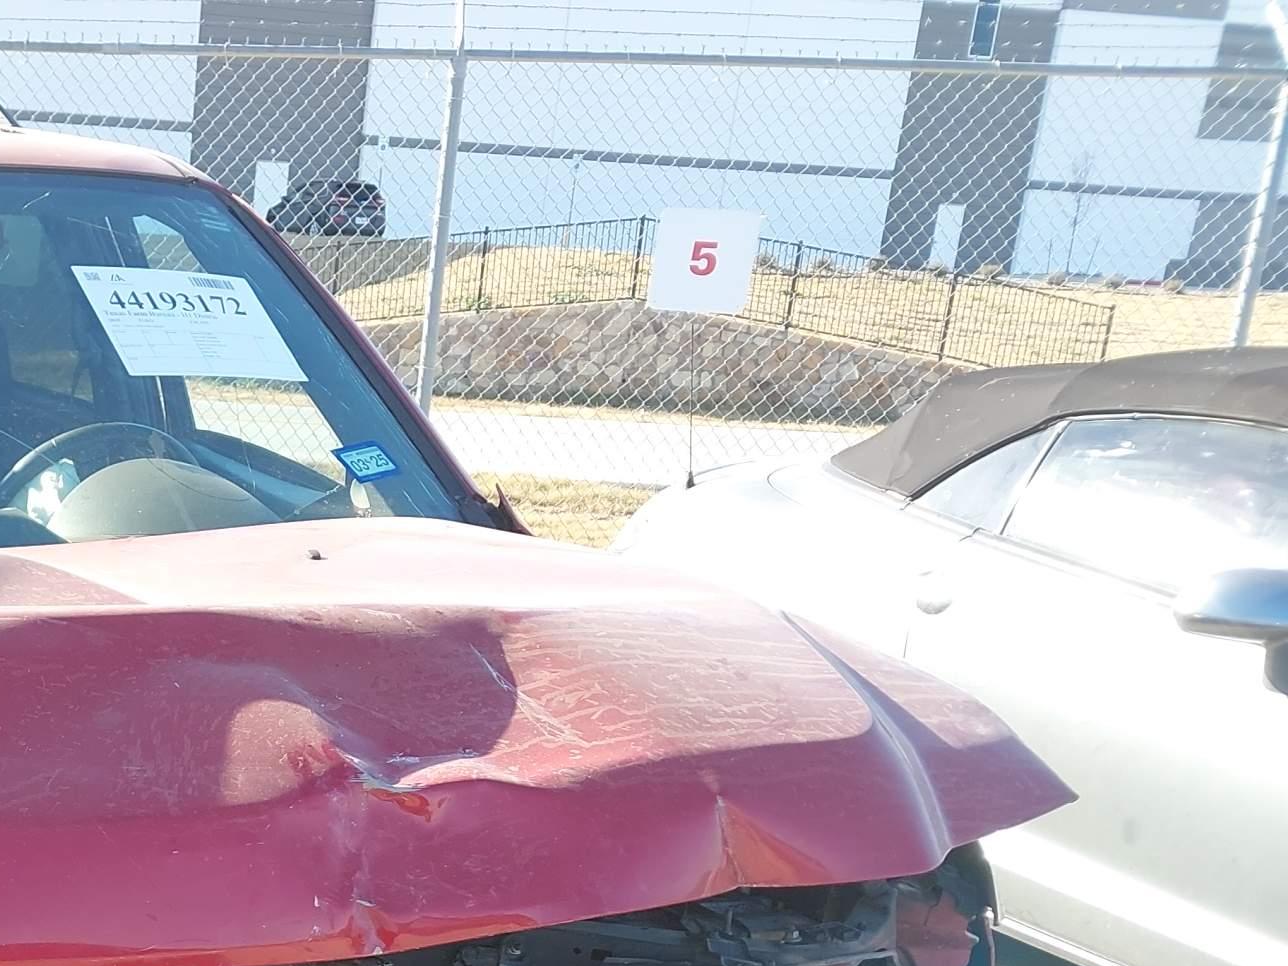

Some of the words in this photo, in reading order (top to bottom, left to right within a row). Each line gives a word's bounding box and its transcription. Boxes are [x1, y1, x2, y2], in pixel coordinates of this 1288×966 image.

[689, 241, 719, 276] 5
[109, 290, 247, 316] 44193172
[370, 454, 389, 467] 25
